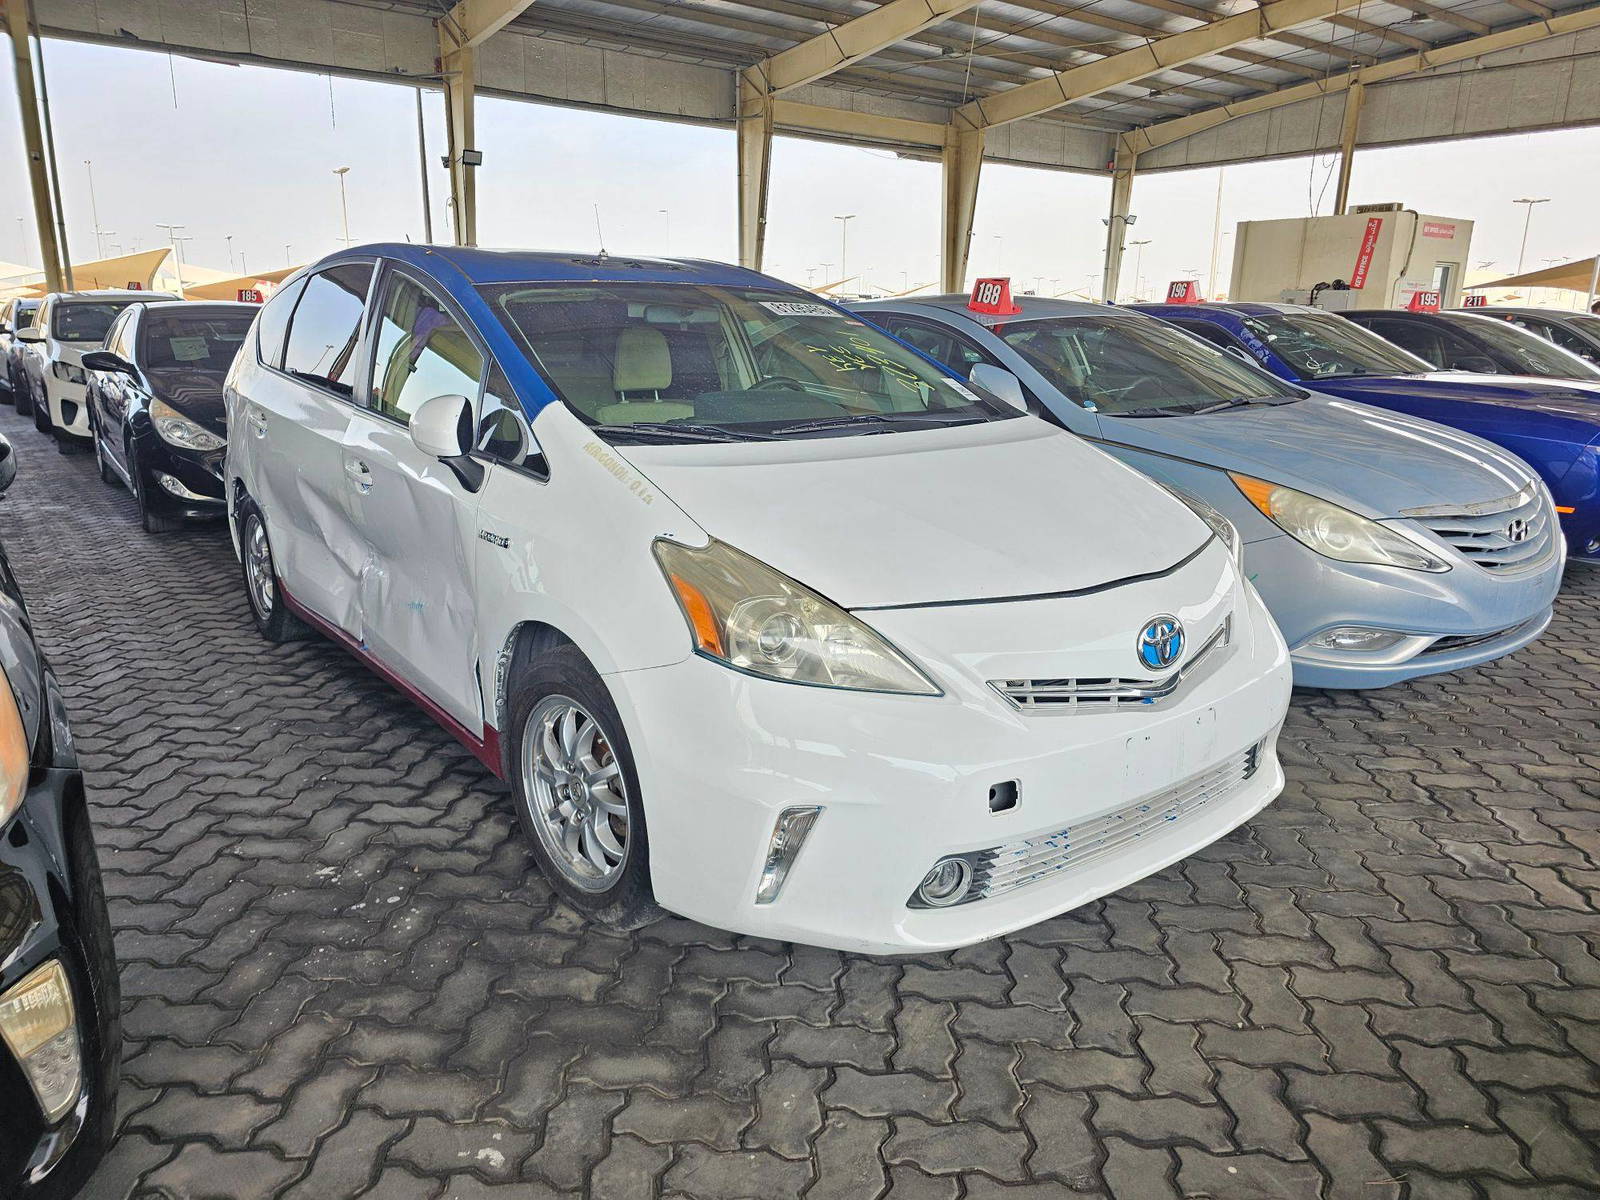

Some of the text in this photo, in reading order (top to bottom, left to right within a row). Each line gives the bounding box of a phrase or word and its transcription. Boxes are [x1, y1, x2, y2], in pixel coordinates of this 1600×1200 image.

[1358, 255, 1369, 275] OFFICE
[241, 290, 257, 302] 185
[977, 281, 1002, 306] 188
[1170, 282, 1188, 299] 196
[1420, 292, 1438, 307] 195
[1466, 295, 1482, 307] 211
